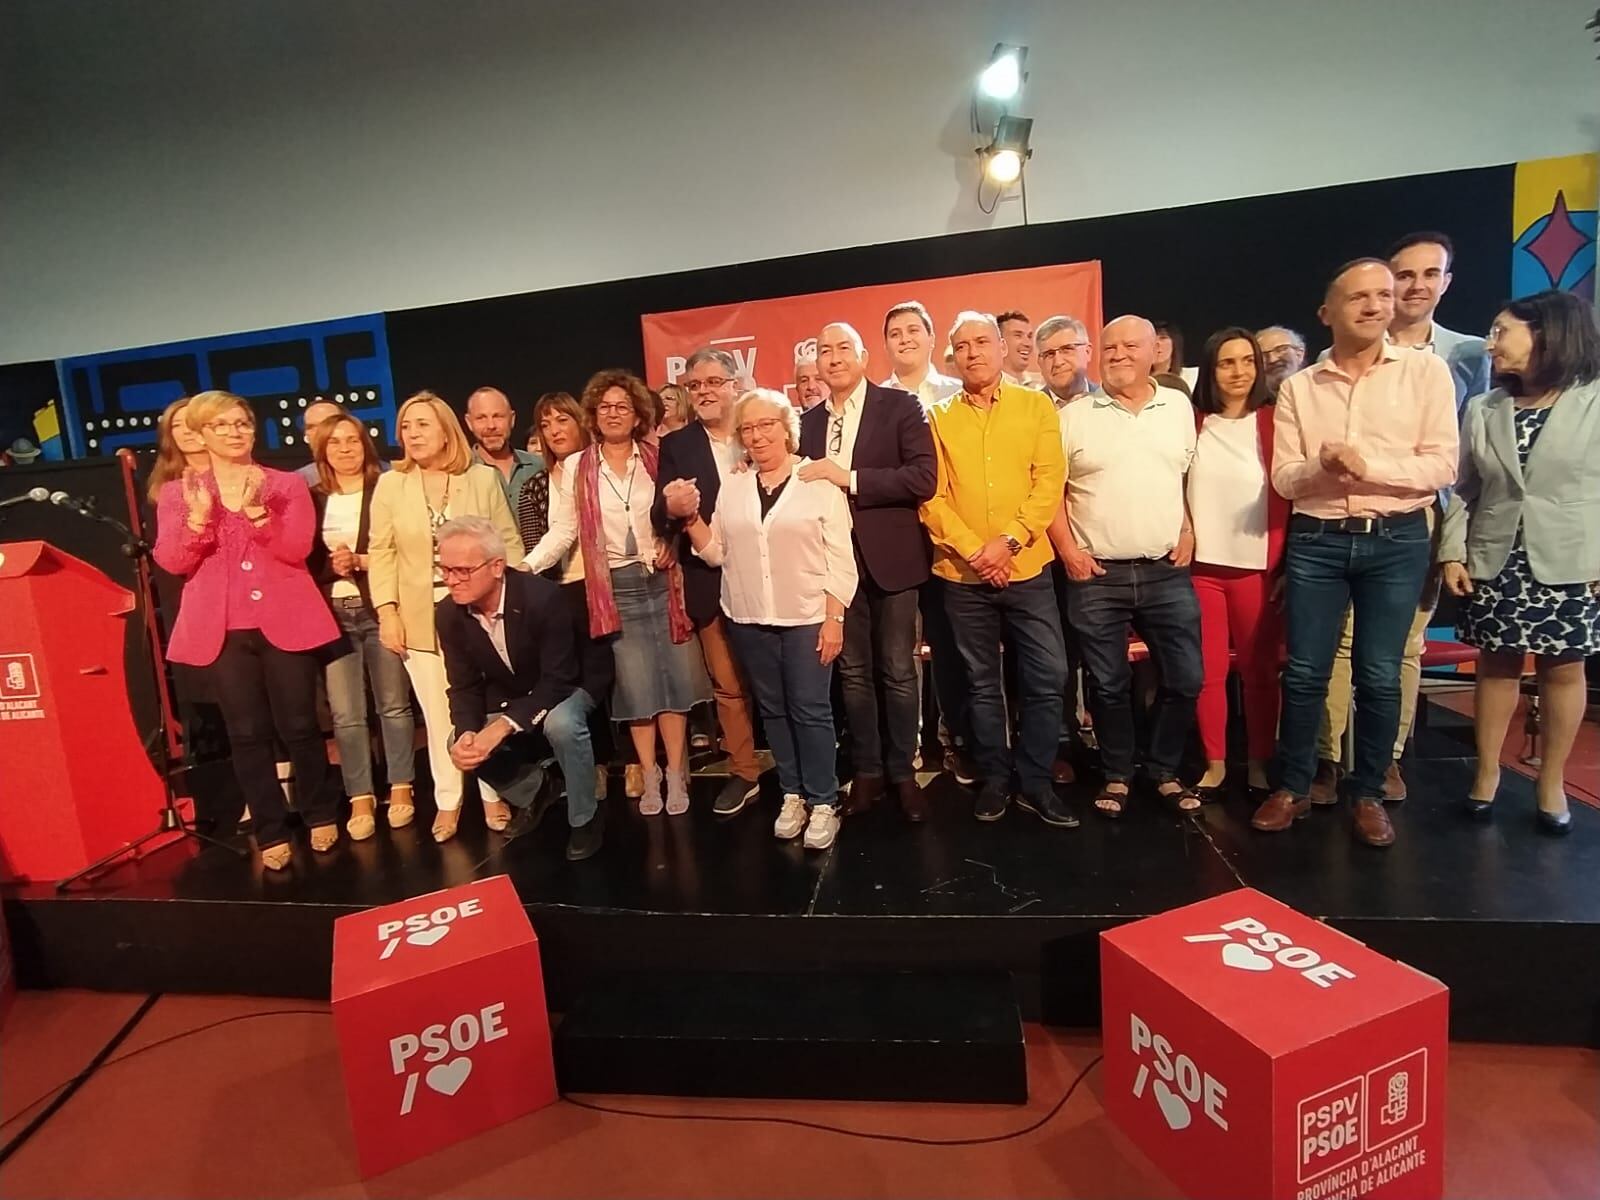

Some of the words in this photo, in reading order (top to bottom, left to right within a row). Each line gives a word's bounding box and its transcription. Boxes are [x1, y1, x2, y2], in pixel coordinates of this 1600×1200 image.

[666, 347, 757, 386] PV
[378, 898, 484, 941] PSOE
[1219, 917, 1357, 988] PSOE
[389, 1001, 509, 1075] PSOE
[1130, 1012, 1229, 1132] PSOE
[1303, 1092, 1359, 1136] PSPV
[1303, 1117, 1359, 1165] PSOE
[1361, 1135, 1419, 1176] D'ALACANT
[1360, 1176, 1374, 1195] DE
[1376, 1149, 1426, 1187] ALICANTE
